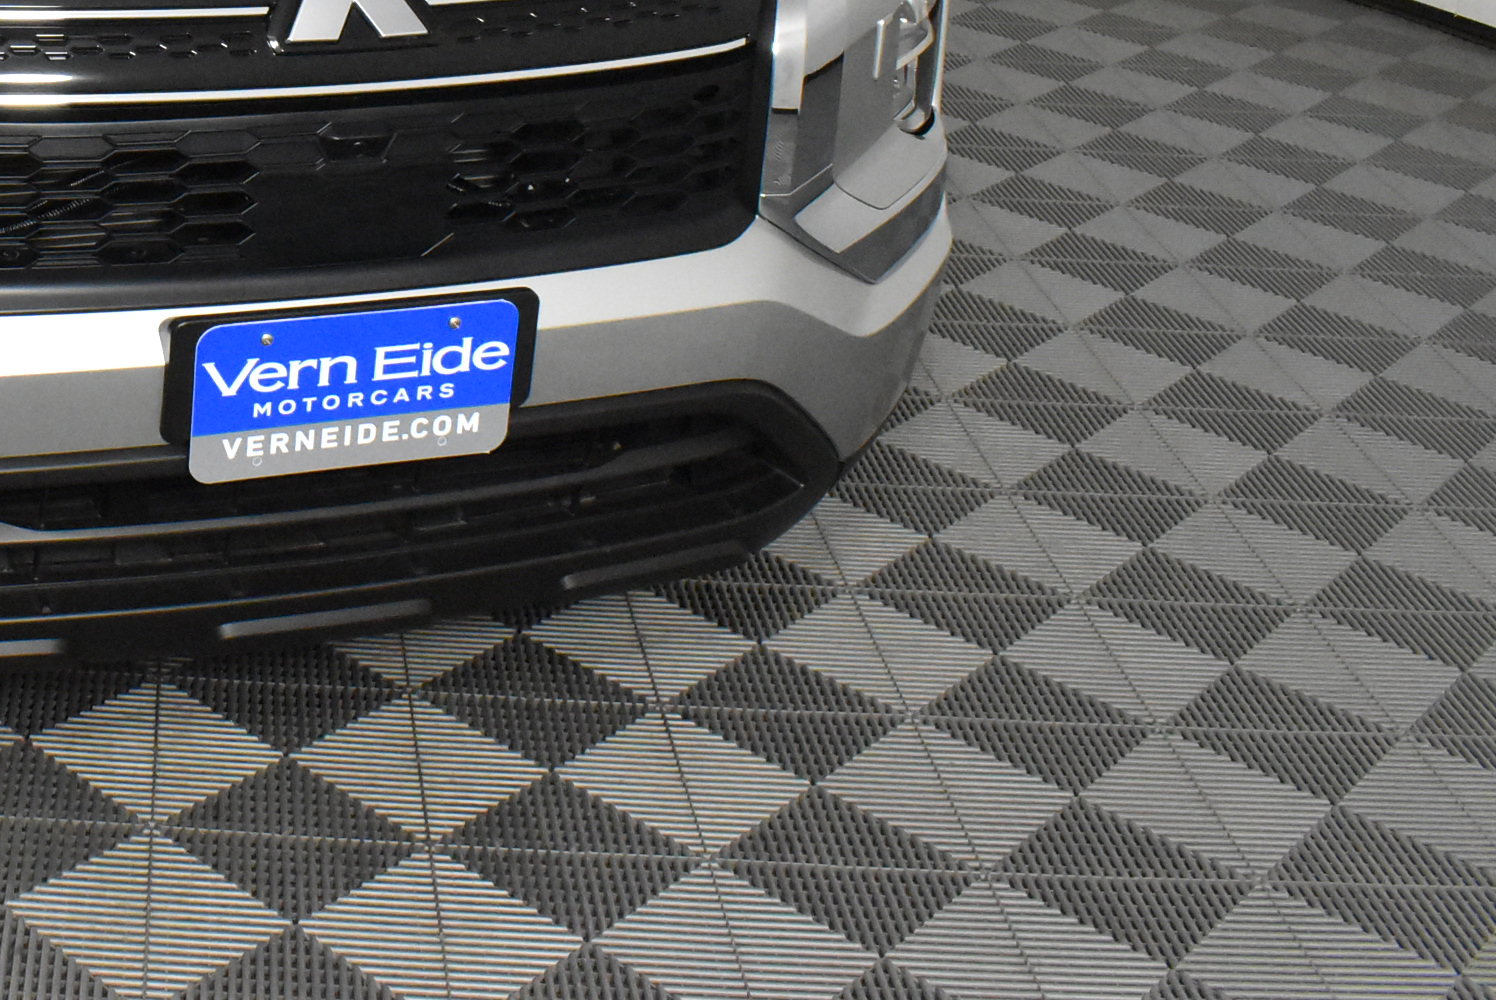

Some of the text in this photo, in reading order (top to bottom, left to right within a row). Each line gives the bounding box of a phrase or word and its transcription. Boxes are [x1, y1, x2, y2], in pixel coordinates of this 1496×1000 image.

[201, 336, 511, 397] Vern Eide
[252, 382, 455, 418] MOTORCARS
[221, 411, 480, 460] VERNEIDE.COM
